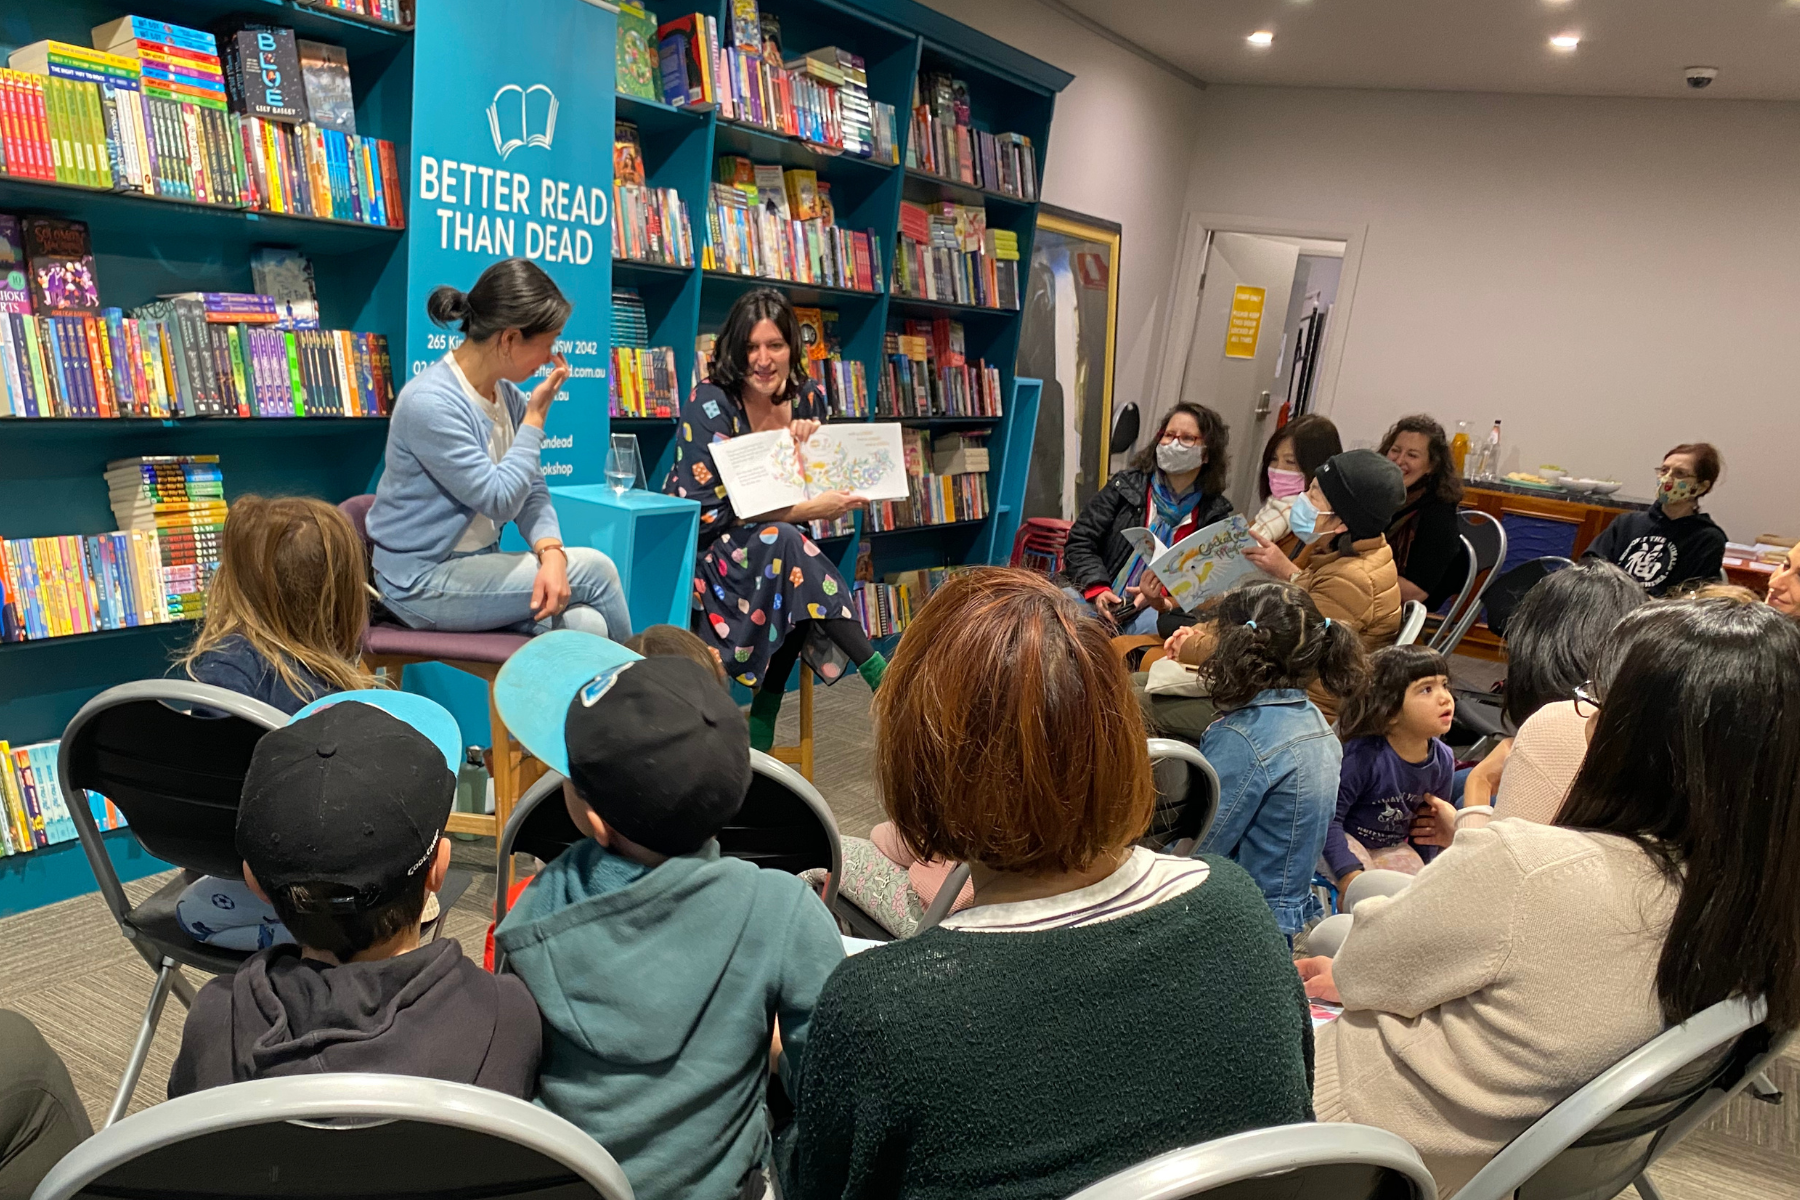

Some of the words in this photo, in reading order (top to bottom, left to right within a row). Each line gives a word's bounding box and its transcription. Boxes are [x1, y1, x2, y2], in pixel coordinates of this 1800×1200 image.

[420, 155, 530, 215] BETTER
[541, 178, 607, 225] READ
[436, 208, 514, 256] THAN
[525, 221, 593, 265] DEAD
[427, 333, 446, 349] 265
[448, 335, 464, 350] Kin
[575, 341, 598, 354] 2042
